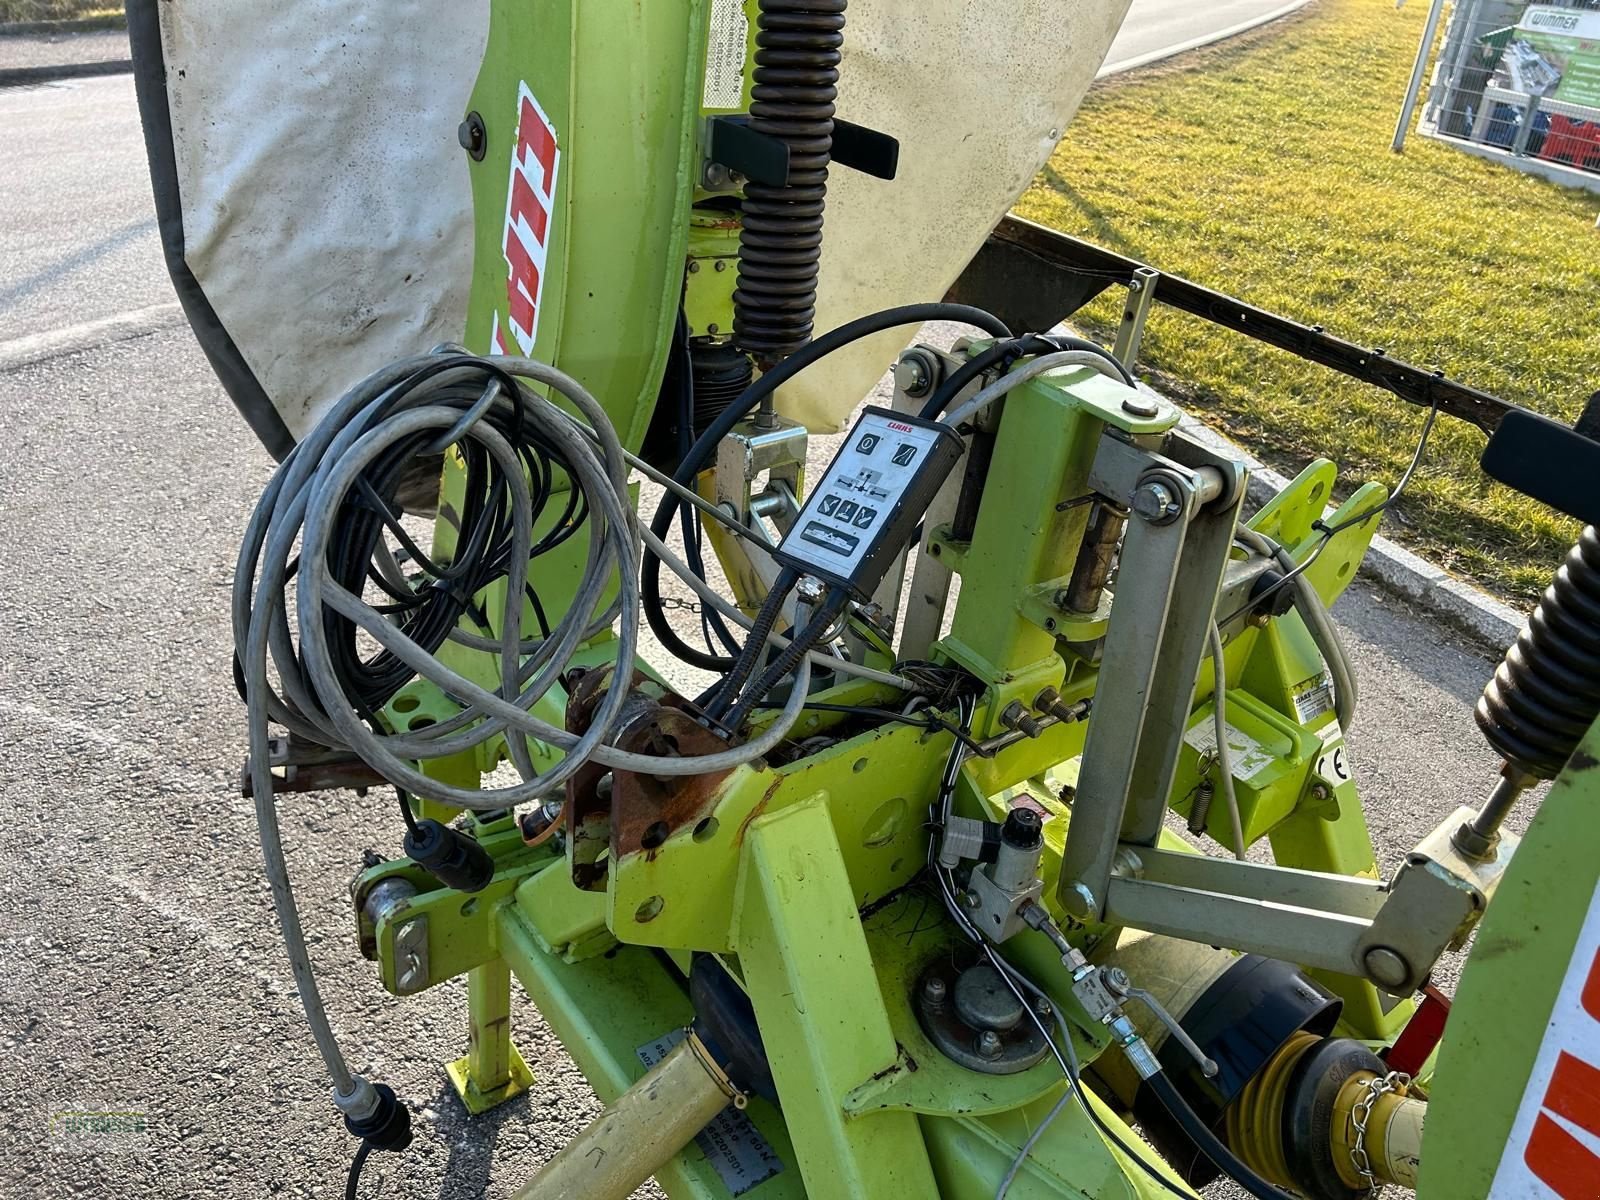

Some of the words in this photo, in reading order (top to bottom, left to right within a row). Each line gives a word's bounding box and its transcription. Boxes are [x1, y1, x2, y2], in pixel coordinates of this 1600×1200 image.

[1531, 13, 1578, 29] WIMMER
[495, 96, 557, 356] CLA
[887, 421, 913, 433] CLAAS
